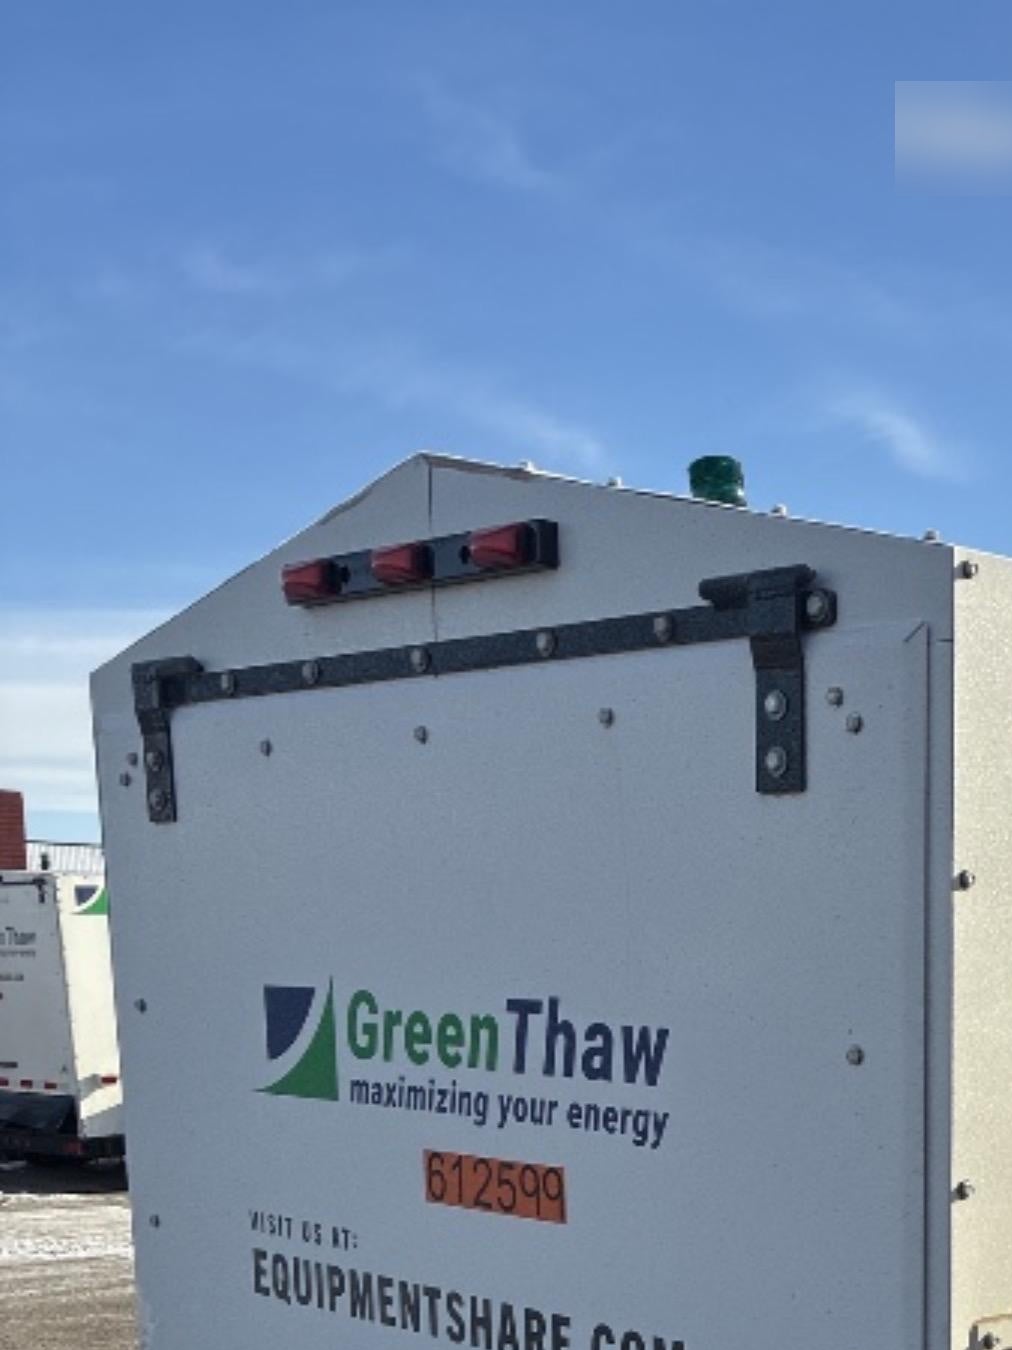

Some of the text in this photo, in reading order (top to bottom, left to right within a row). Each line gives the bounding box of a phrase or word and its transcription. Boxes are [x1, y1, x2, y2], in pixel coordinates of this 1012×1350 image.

[350, 1074, 670, 1150] maximizing your energy
[425, 1151, 567, 1222] 612599
[249, 1209, 293, 1240] VISIT
[302, 1220, 323, 1246] US
